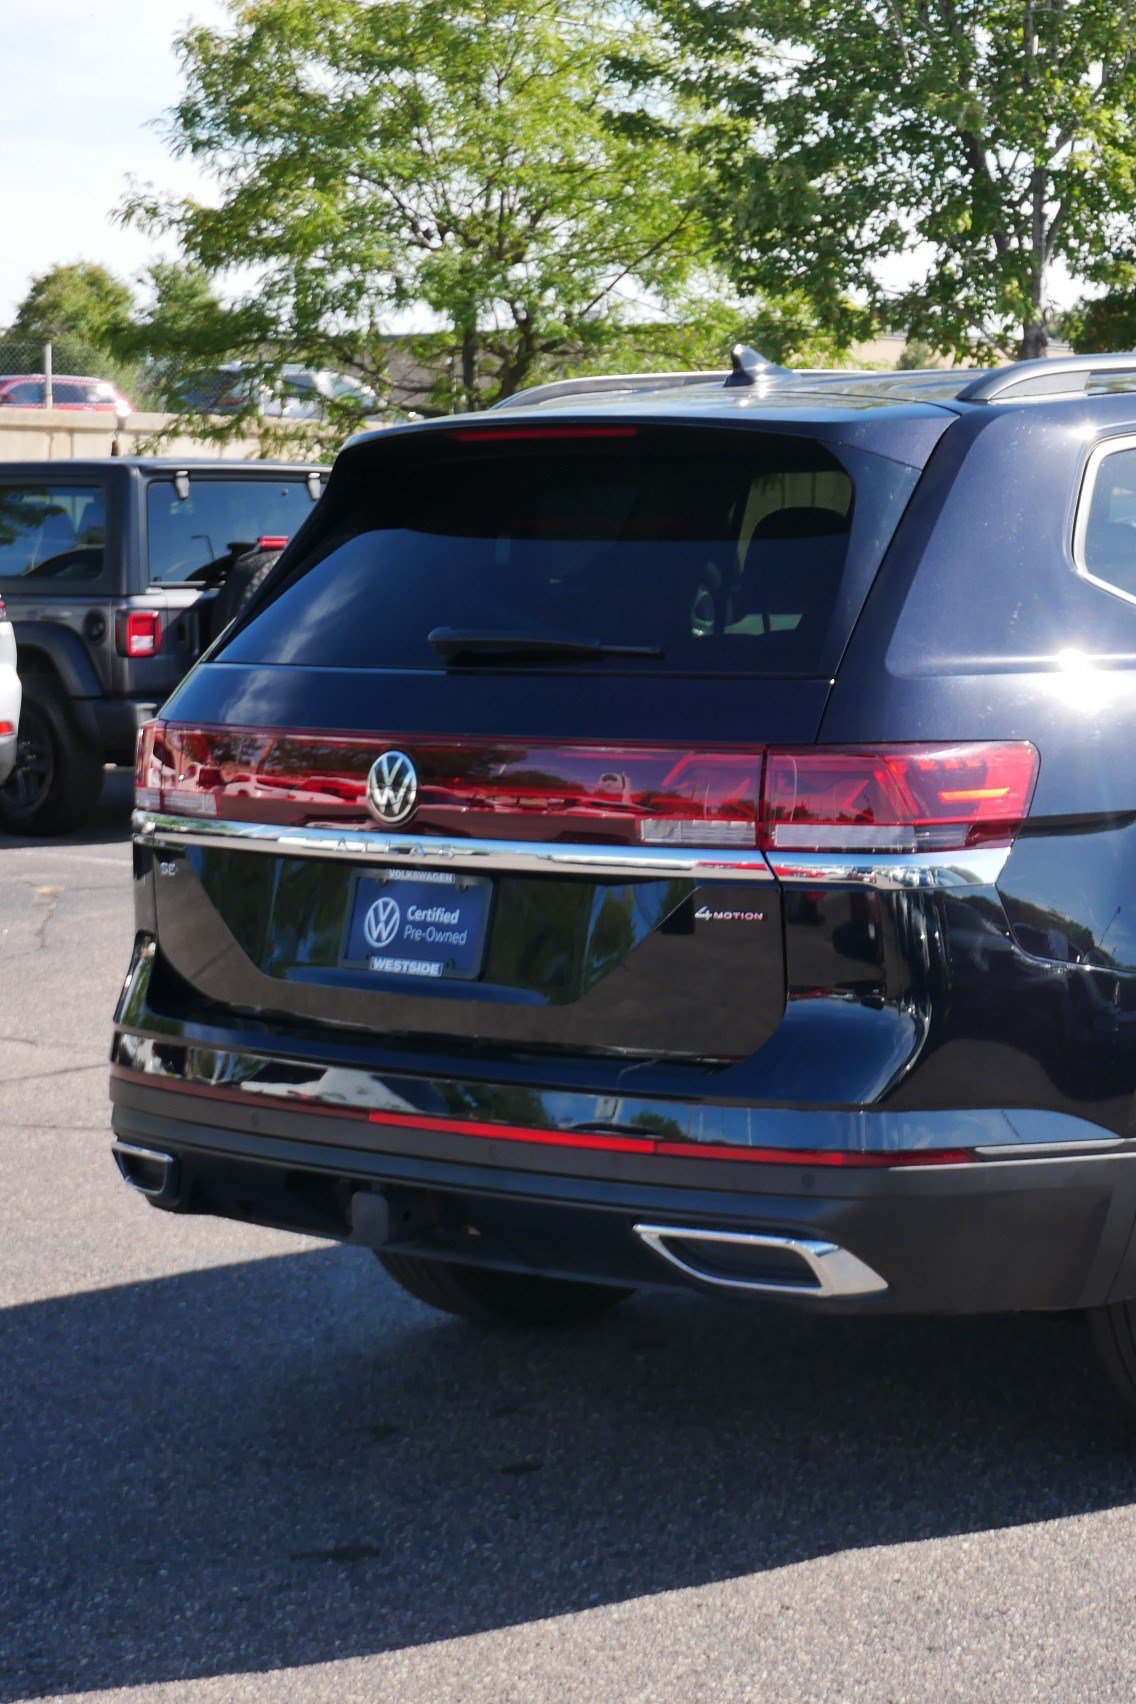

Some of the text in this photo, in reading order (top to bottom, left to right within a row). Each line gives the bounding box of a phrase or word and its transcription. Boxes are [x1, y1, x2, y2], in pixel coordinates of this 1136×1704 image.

[333, 838, 455, 859] ATLAS
[388, 869, 453, 882] VOLKSWAGEN
[407, 905, 460, 925] Certified
[403, 925, 468, 945] Pre-Owned
[372, 957, 441, 976] WESTSIDE
